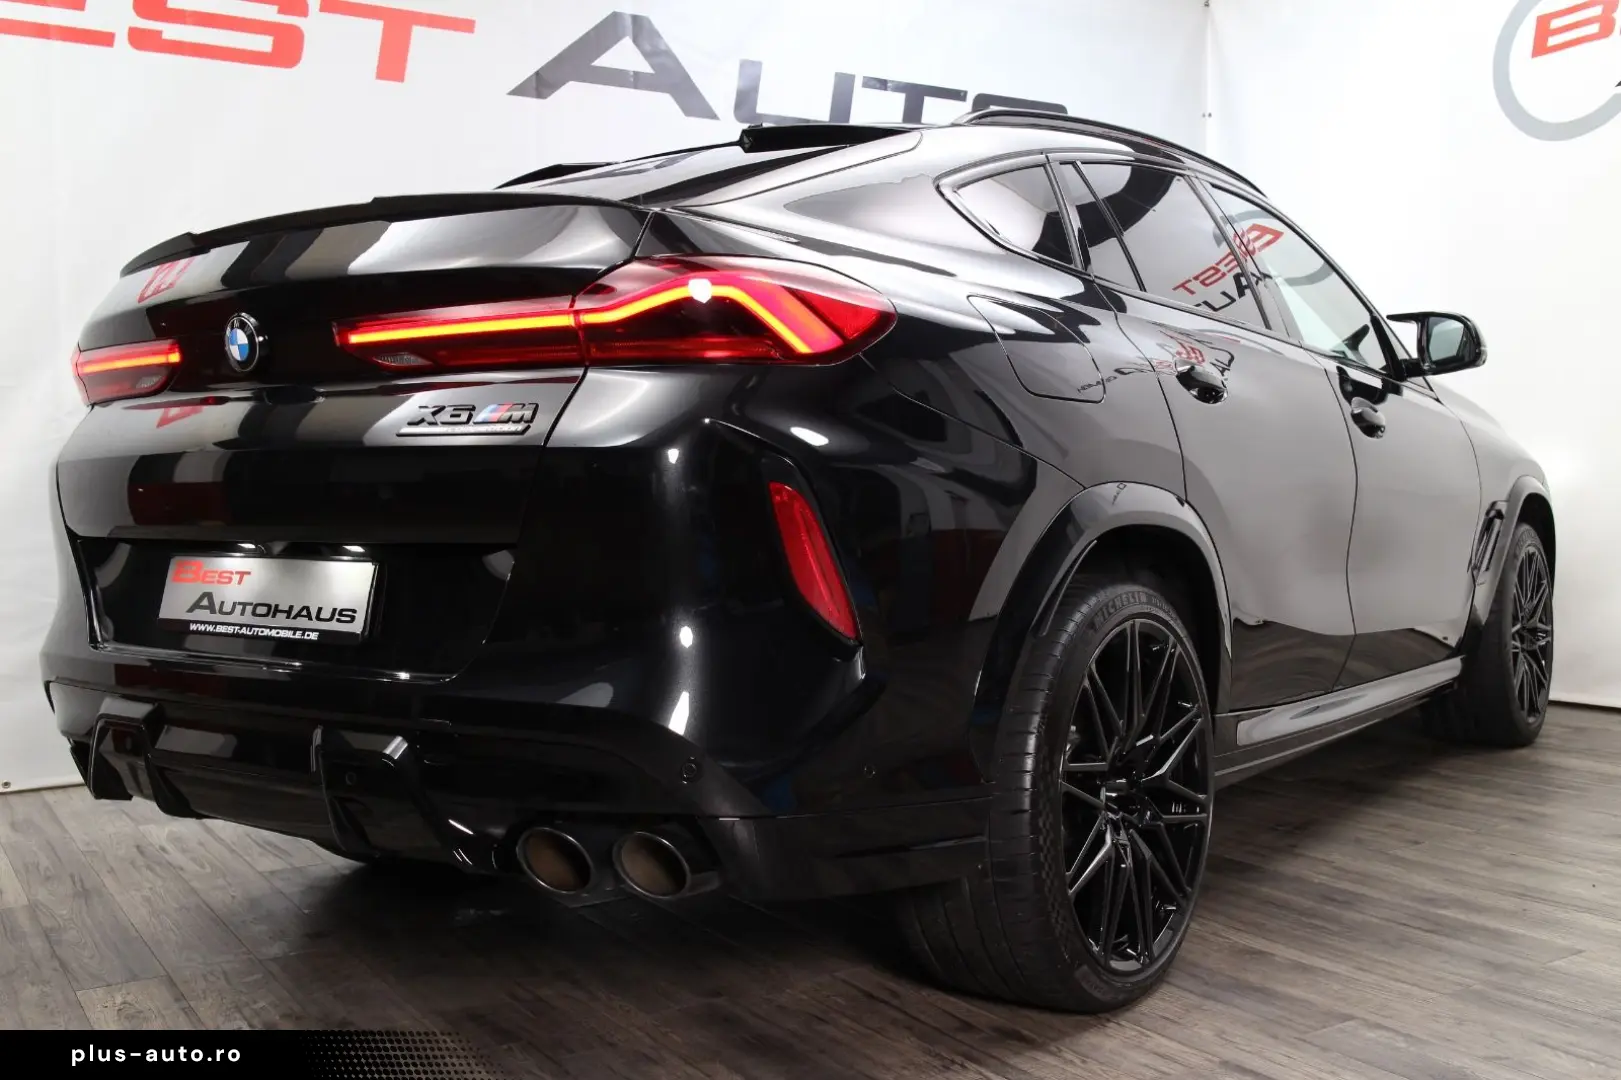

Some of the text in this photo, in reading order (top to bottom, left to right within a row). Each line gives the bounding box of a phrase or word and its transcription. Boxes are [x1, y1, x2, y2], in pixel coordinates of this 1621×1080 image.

[407, 404, 476, 426] X6
[171, 560, 251, 586] BEST
[186, 591, 357, 624] AUTOHAUS
[1093, 591, 1148, 630] MICHELIN
[189, 622, 319, 641] WWW.BEST-AUTOMOBILE.DE
